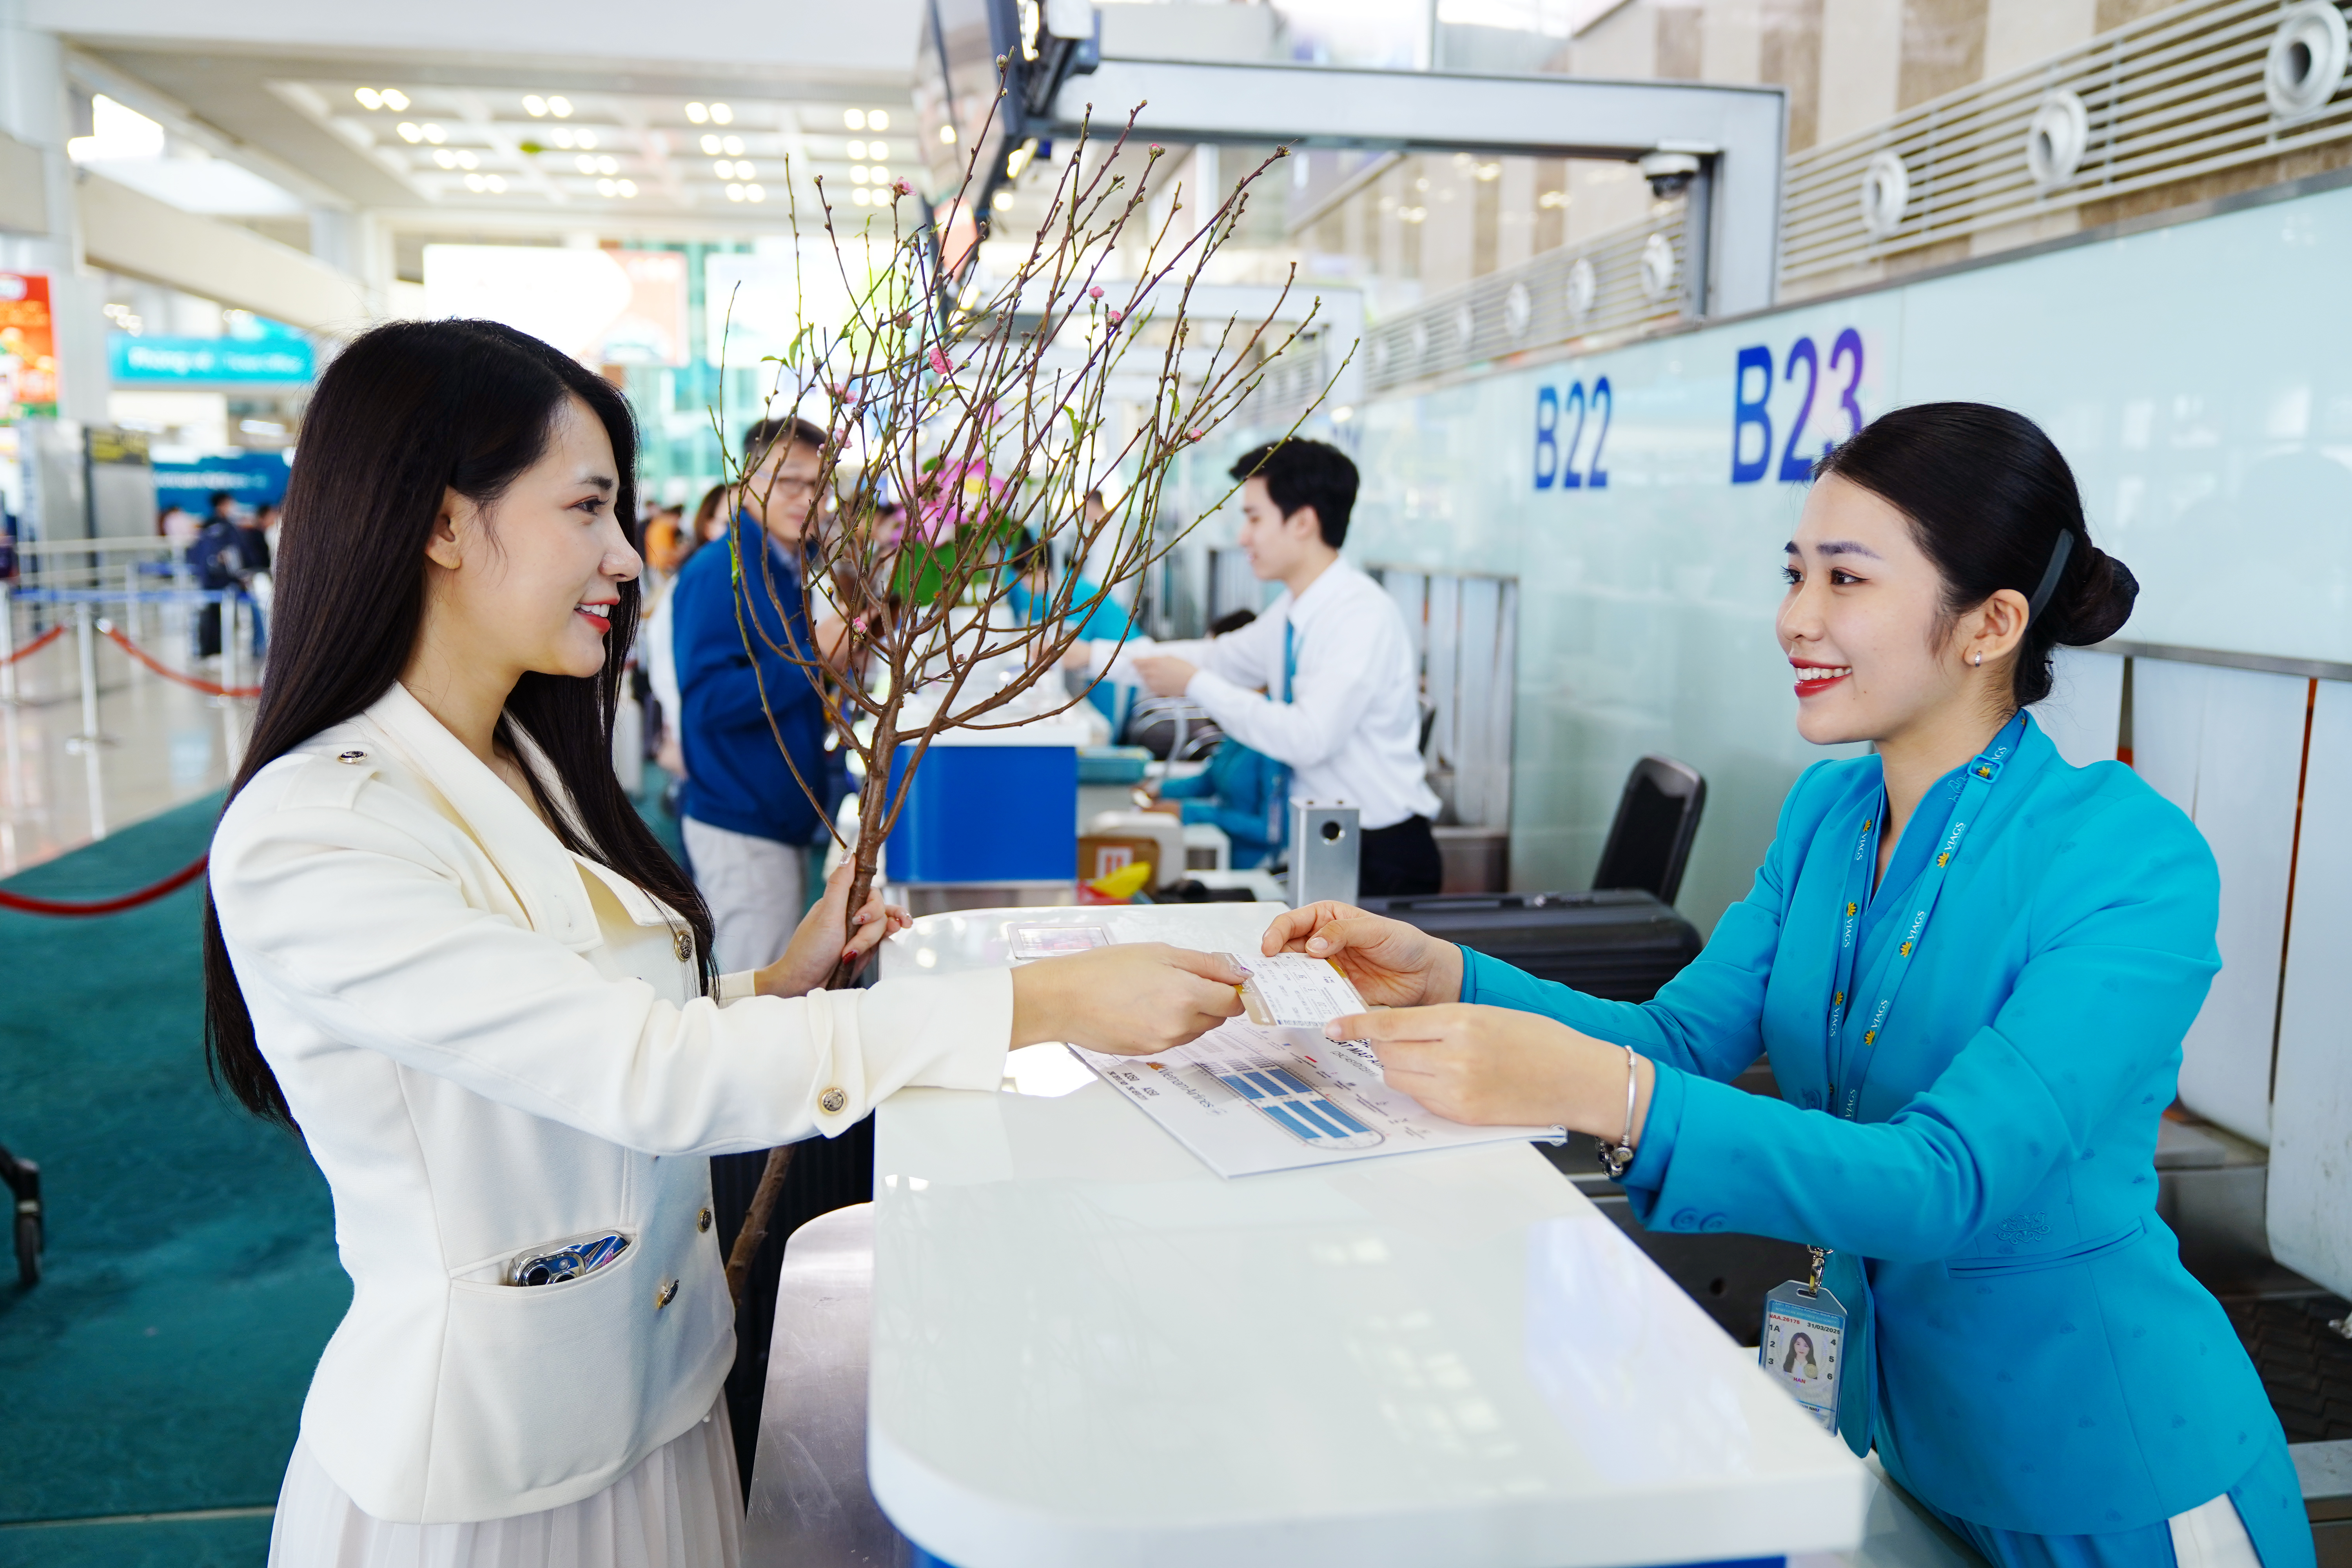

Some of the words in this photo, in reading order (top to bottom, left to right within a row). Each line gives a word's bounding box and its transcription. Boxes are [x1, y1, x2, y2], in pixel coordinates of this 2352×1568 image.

[1732, 328, 1864, 483] B23
[1534, 376, 1611, 489] B22
[1856, 833, 1867, 860] VIAGS
[1944, 822, 1964, 850] VIAGS
[1844, 918, 1853, 948] VIAGS
[1907, 911, 1924, 939] VIAGS
[1316, 1002, 1332, 1014] 11:20
[1830, 1007, 1840, 1037] VIAGS
[1871, 999, 1887, 1028] VIAGS
[1347, 1048, 1373, 1058] MAP
[1122, 1073, 1140, 1081] A350
[1141, 1087, 1159, 1096] A350
[1845, 1088, 1856, 1117] VIAGS
[1807, 1322, 1840, 1334] 31/03/2025
